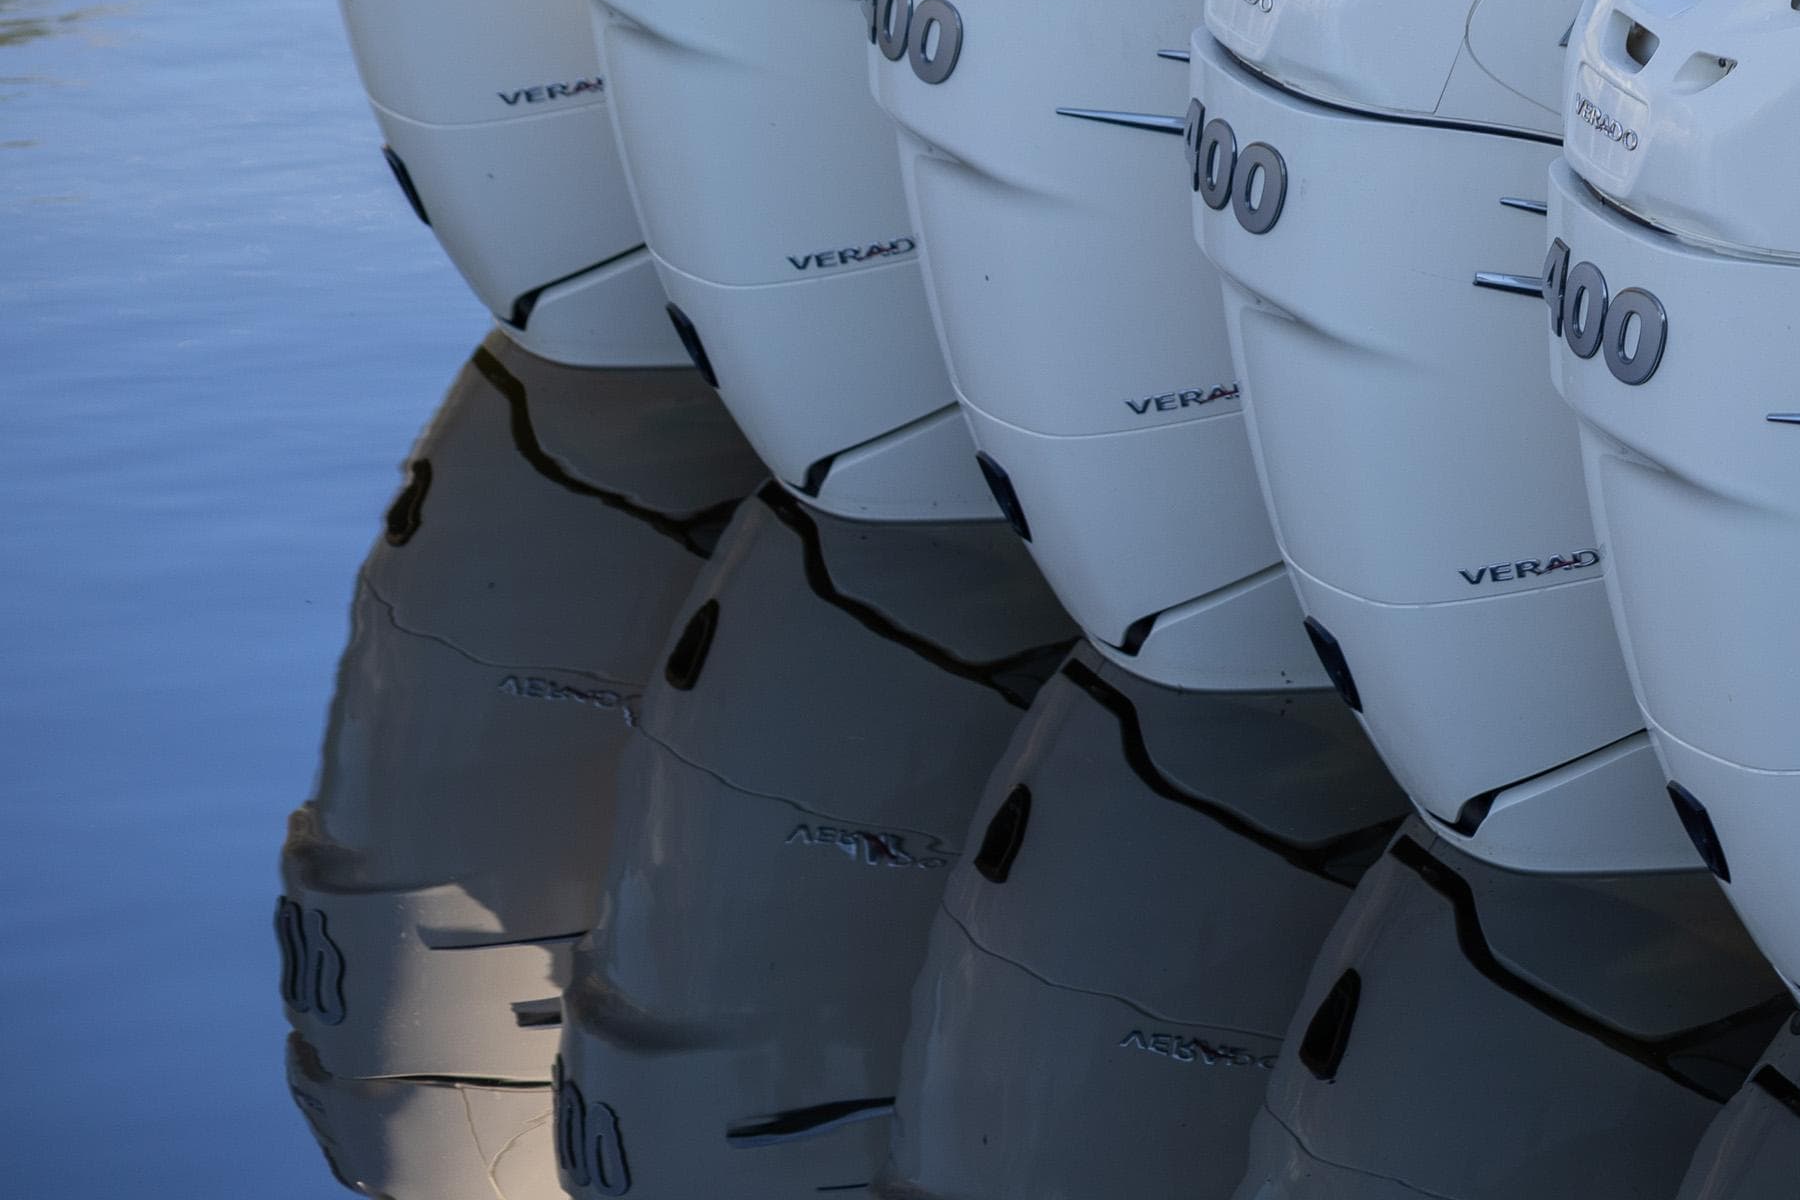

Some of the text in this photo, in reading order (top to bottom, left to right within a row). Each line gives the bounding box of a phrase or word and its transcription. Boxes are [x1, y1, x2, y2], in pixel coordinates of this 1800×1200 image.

[1576, 92, 1639, 151] VERADO
[1184, 97, 1288, 235] 400
[787, 237, 916, 270] VERAD
[1542, 237, 1668, 386] 400
[1458, 547, 1604, 585] VERAD
